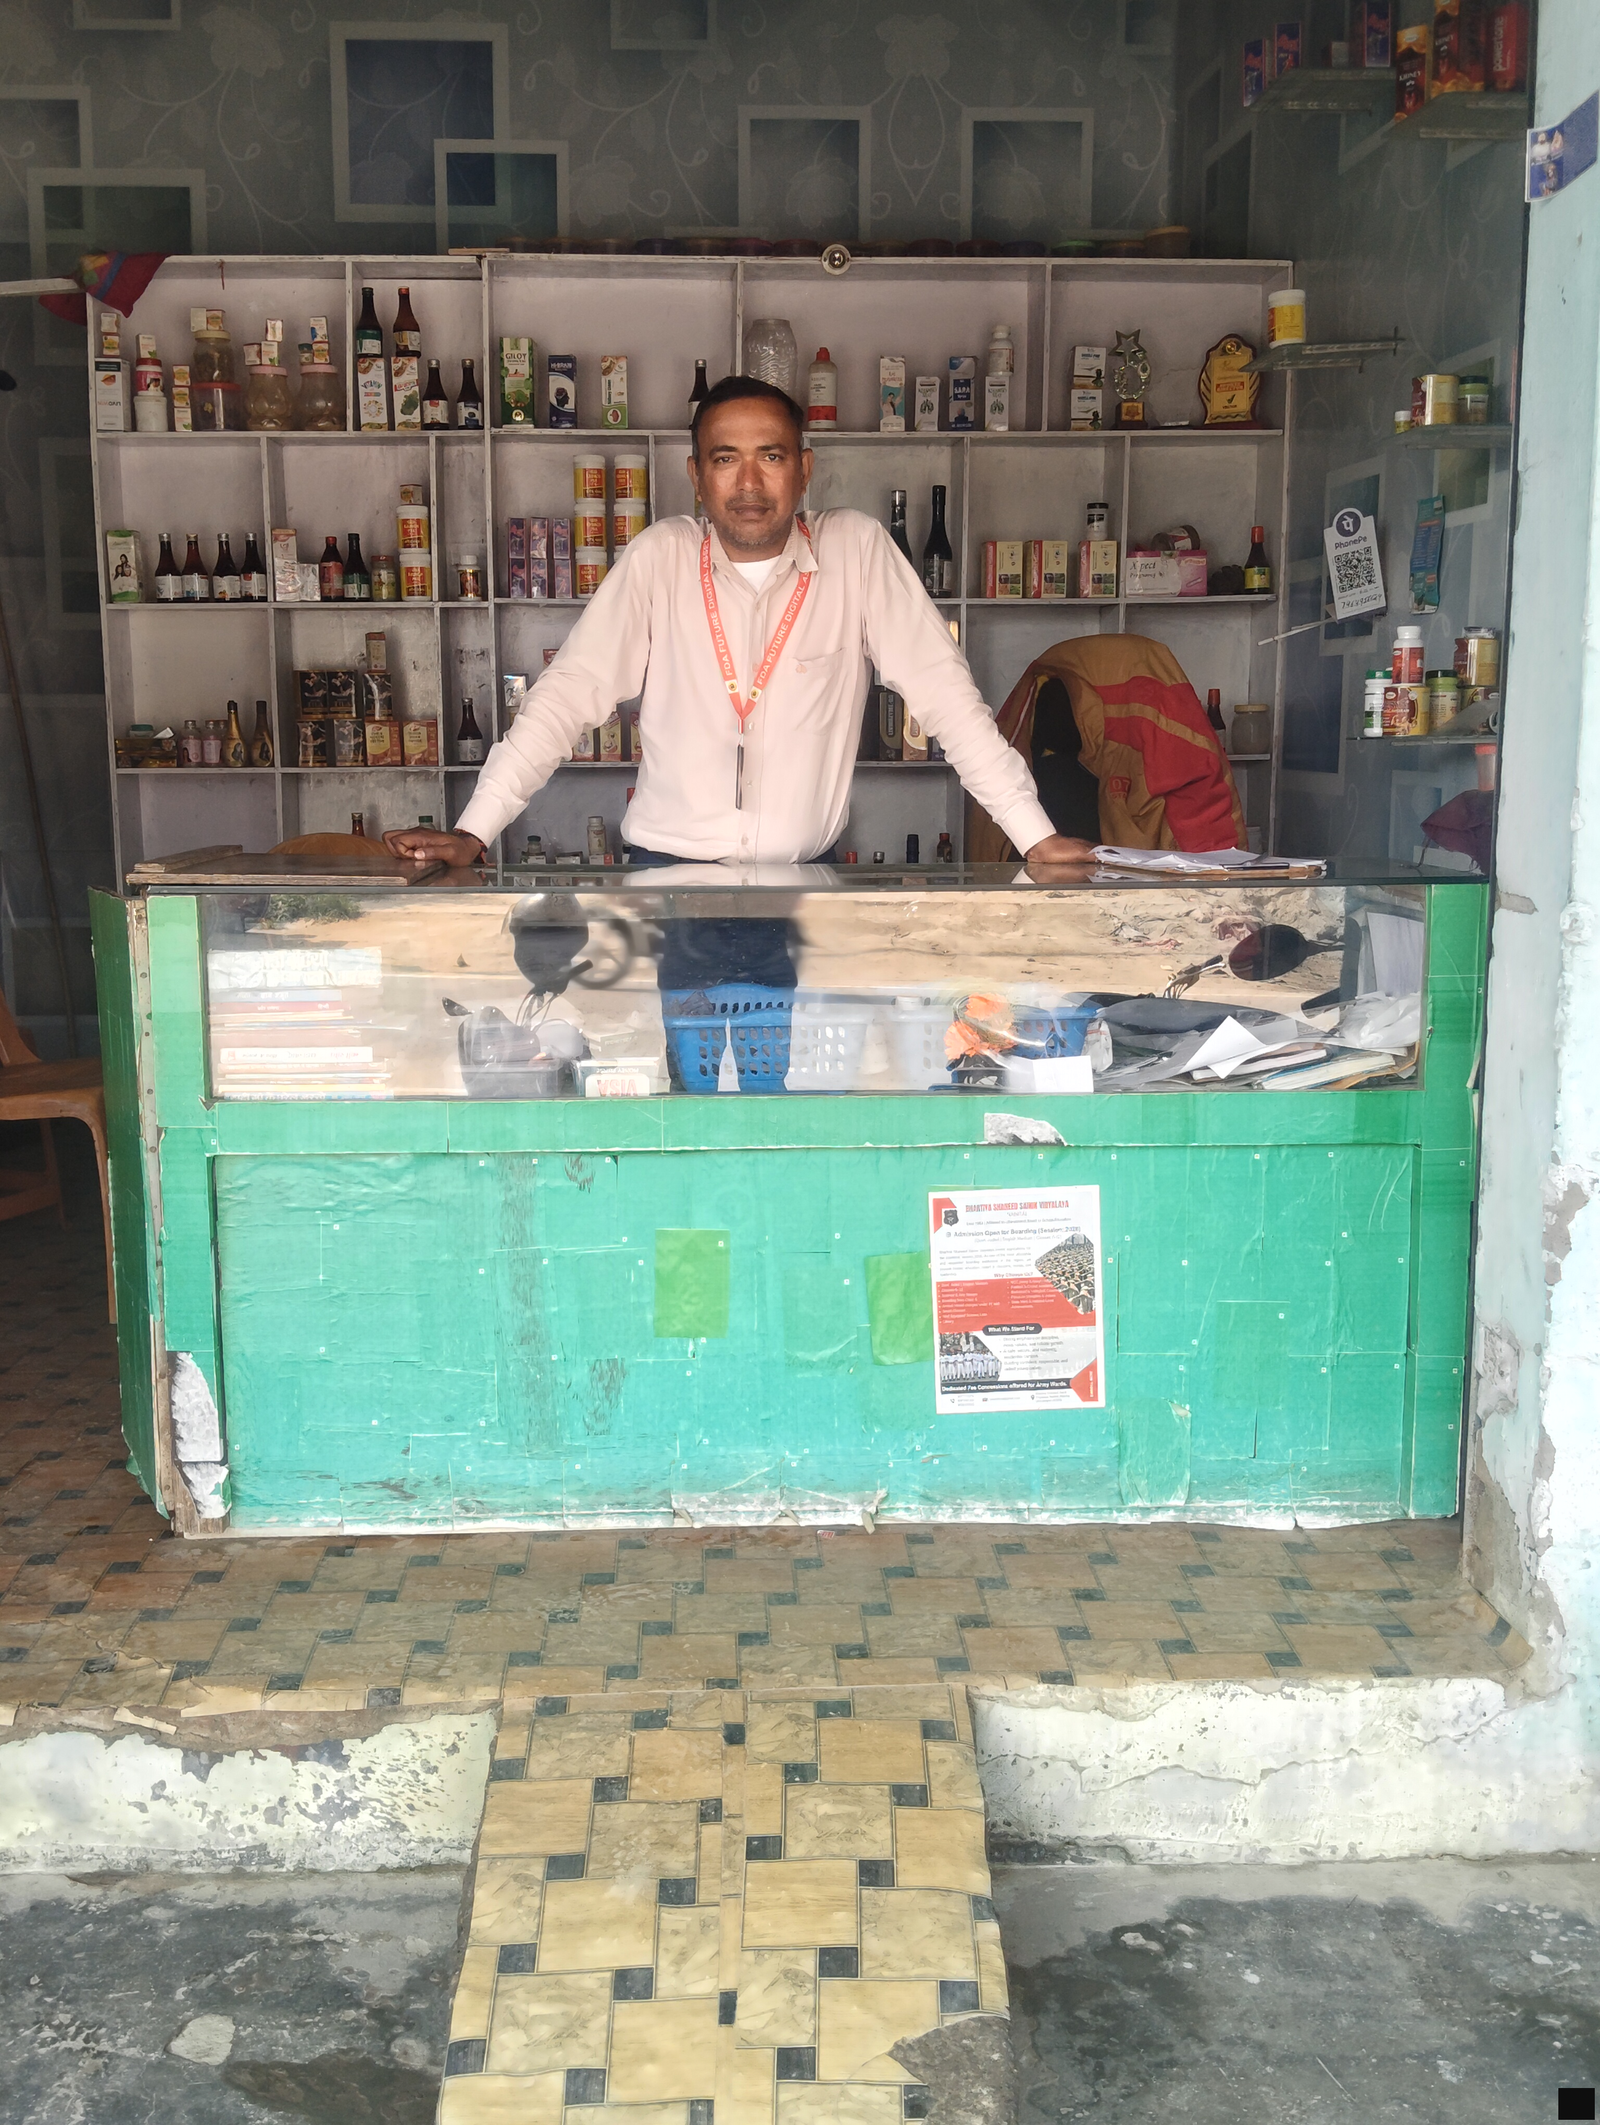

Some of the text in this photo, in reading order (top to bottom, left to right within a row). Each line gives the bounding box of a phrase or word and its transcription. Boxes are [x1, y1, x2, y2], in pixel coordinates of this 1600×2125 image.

[505, 352, 527, 360] GILOY
[1334, 535, 1368, 550] PhonePe
[704, 569, 716, 610] DIGITAL
[710, 610, 727, 653] FUTURE
[757, 585, 806, 685] FDA FUTURE DIGITAL
[721, 655, 733, 676] FDA
[597, 1079, 639, 1097] VISA
[965, 1203, 992, 1212] BHARTIYA
[993, 1202, 1018, 1211] SHAHEED
[1039, 1200, 1070, 1209] VIDYALAYA
[1010, 1228, 1037, 1236] Boarding
[1036, 1381, 1049, 1389] Army
